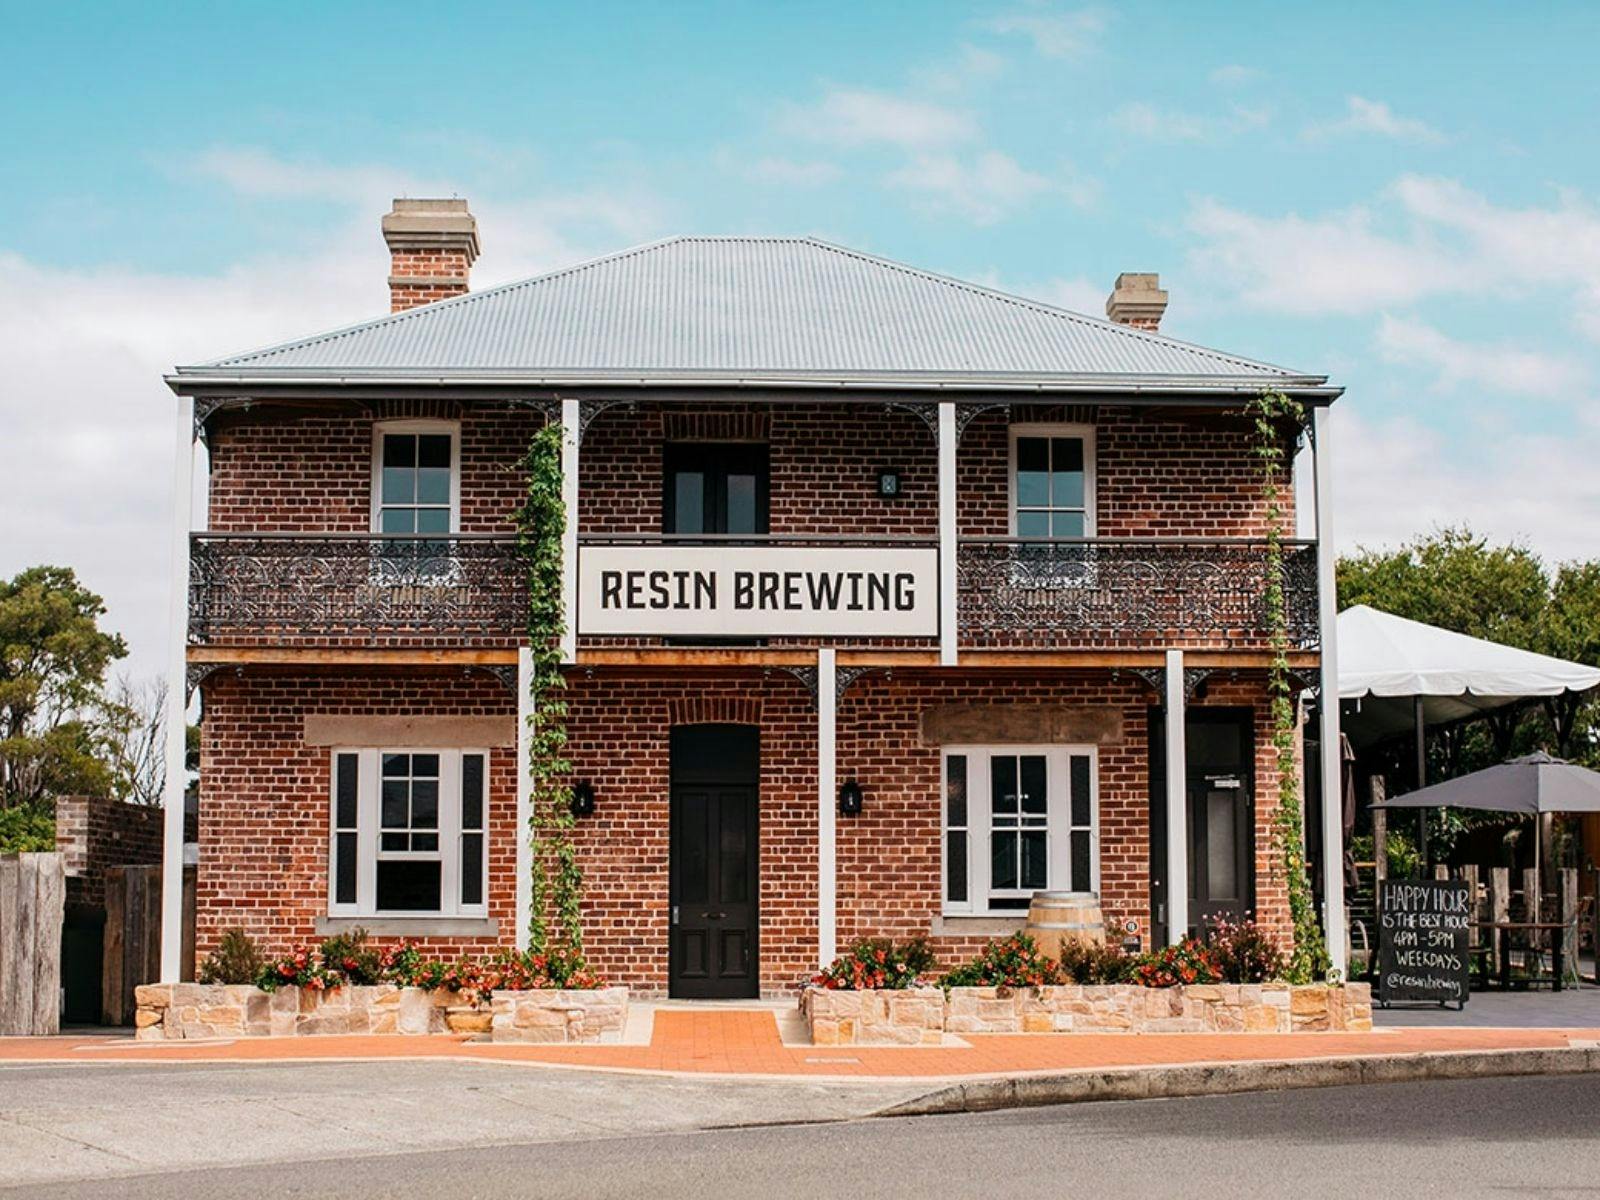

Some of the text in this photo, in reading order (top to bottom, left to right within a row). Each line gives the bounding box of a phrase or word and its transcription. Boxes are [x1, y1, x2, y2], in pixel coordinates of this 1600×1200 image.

[601, 571, 915, 611] RESIN BREWING
[1384, 885, 1468, 912] HAPPY HOUR
[1382, 913, 1469, 929] IS THE BEST HOUR
[1393, 931, 1418, 947] 4PM
[1428, 931, 1454, 949] 5PM
[1395, 950, 1461, 971] WEEKDAYS
